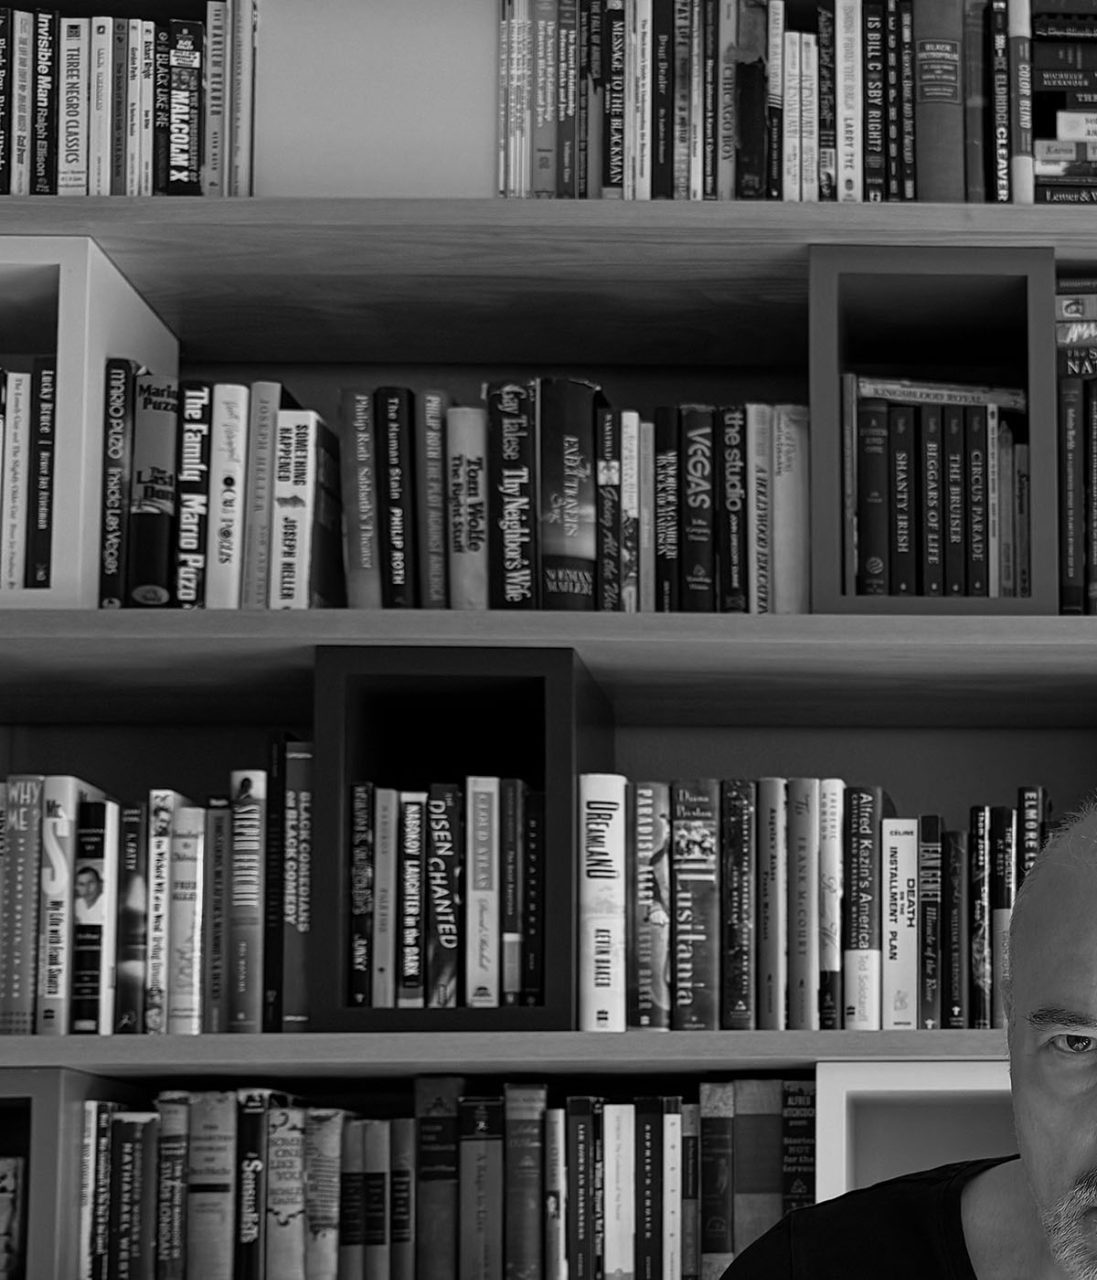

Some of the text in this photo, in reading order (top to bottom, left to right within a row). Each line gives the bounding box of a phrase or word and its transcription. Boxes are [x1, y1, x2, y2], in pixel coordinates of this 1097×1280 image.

[35, 14, 52, 176] Invisible Man Ralph Ellison
[64, 47, 81, 164] THREE NEGRO CLASSICS
[156, 53, 170, 128] BLACK LIKE ME
[169, 89, 190, 183] MALCOLM X
[996, 127, 1008, 202] CLEAVER
[177, 386, 210, 600] The Family Mario Puzo
[277, 427, 294, 483] HAPPENED
[293, 424, 309, 487] SOMETHING
[497, 385, 532, 603] Gay Talese Thy Neighbor's Wife
[686, 426, 712, 509] VEGAS
[724, 412, 745, 512] the studio
[466, 456, 485, 553] Tom Wolfe
[281, 517, 298, 600] JOSEPH HELLER
[285, 809, 299, 865] BLACK
[296, 791, 311, 932] BLACK COMEDIANS
[429, 800, 454, 857] DISEN
[585, 800, 620, 880] DREAMLAND
[858, 793, 874, 950] Alfred Kazin's America
[284, 867, 298, 925] COMEDY
[428, 857, 458, 949] CHANTED
[676, 873, 717, 1006] Lusitania
[888, 846, 899, 961] INSTALLMENT PLAN
[906, 878, 916, 929] DEATH
